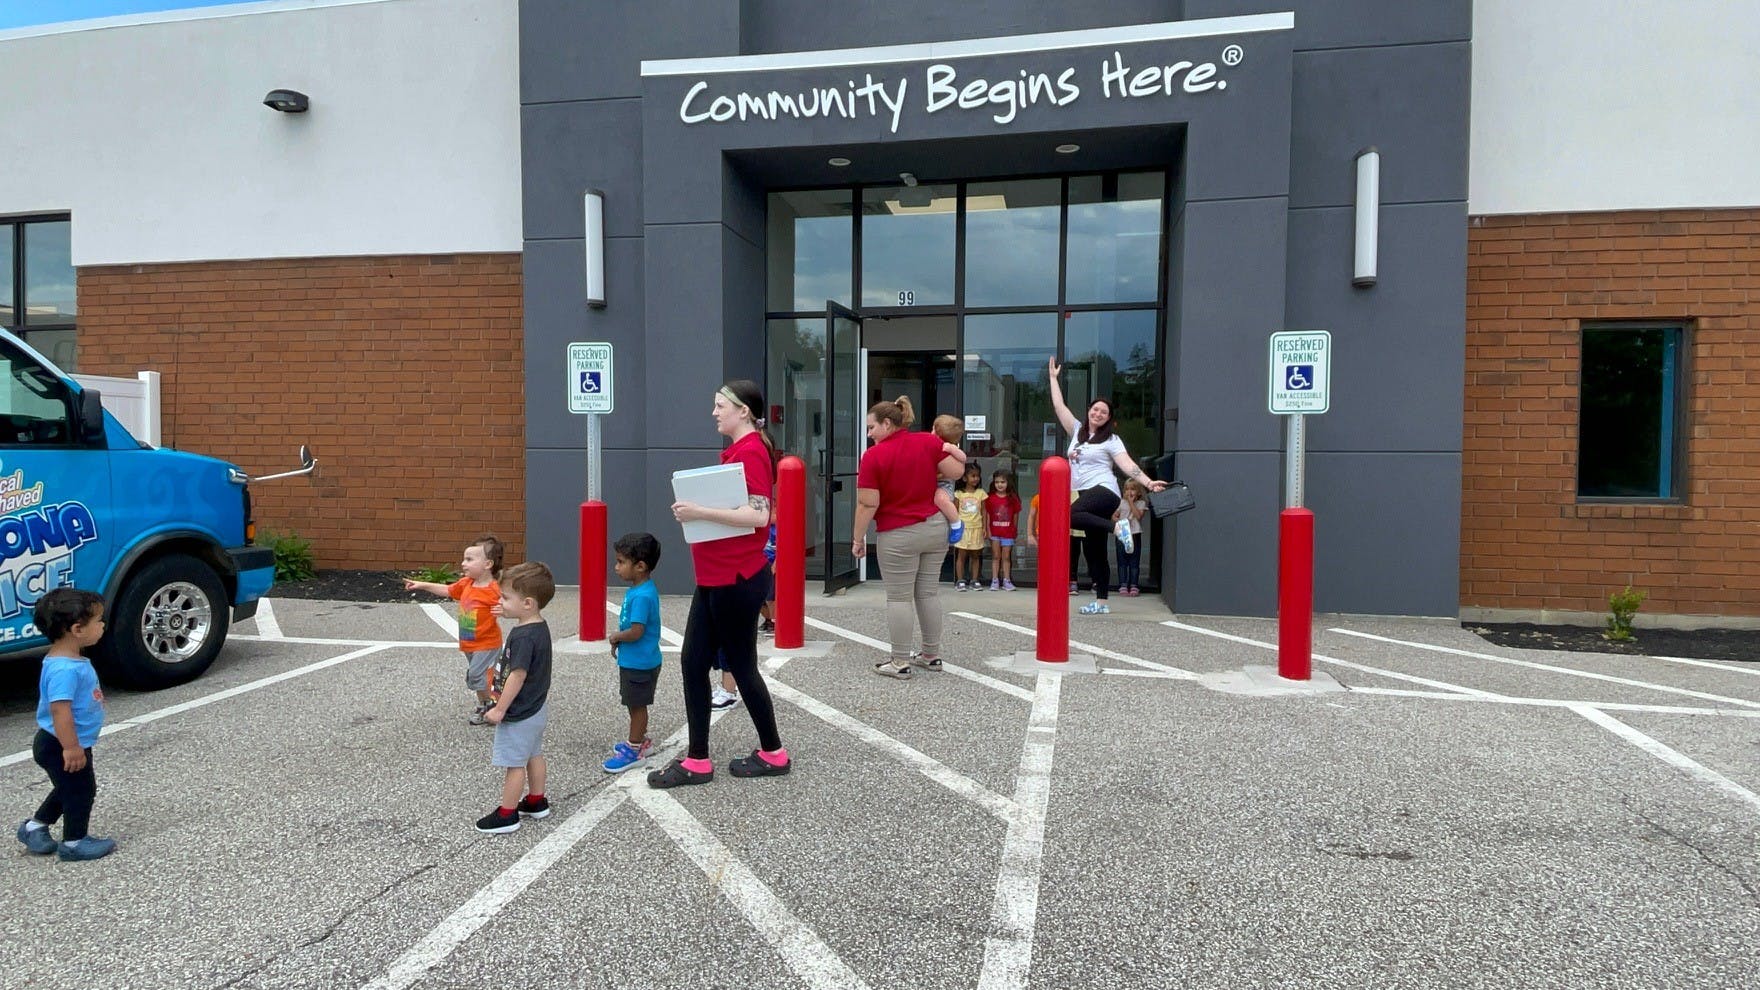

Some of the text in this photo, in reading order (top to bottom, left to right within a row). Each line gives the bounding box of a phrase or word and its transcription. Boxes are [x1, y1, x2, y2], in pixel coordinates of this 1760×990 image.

[680, 74, 907, 133] Community
[926, 65, 1080, 123] Begins
[898, 291, 914, 306] 99
[1277, 339, 1324, 351] RESERVED
[573, 349, 608, 360] RESERVED
[1282, 352, 1319, 363] PARKING
[577, 361, 604, 370] PARKING
[0, 552, 73, 617] ICE
